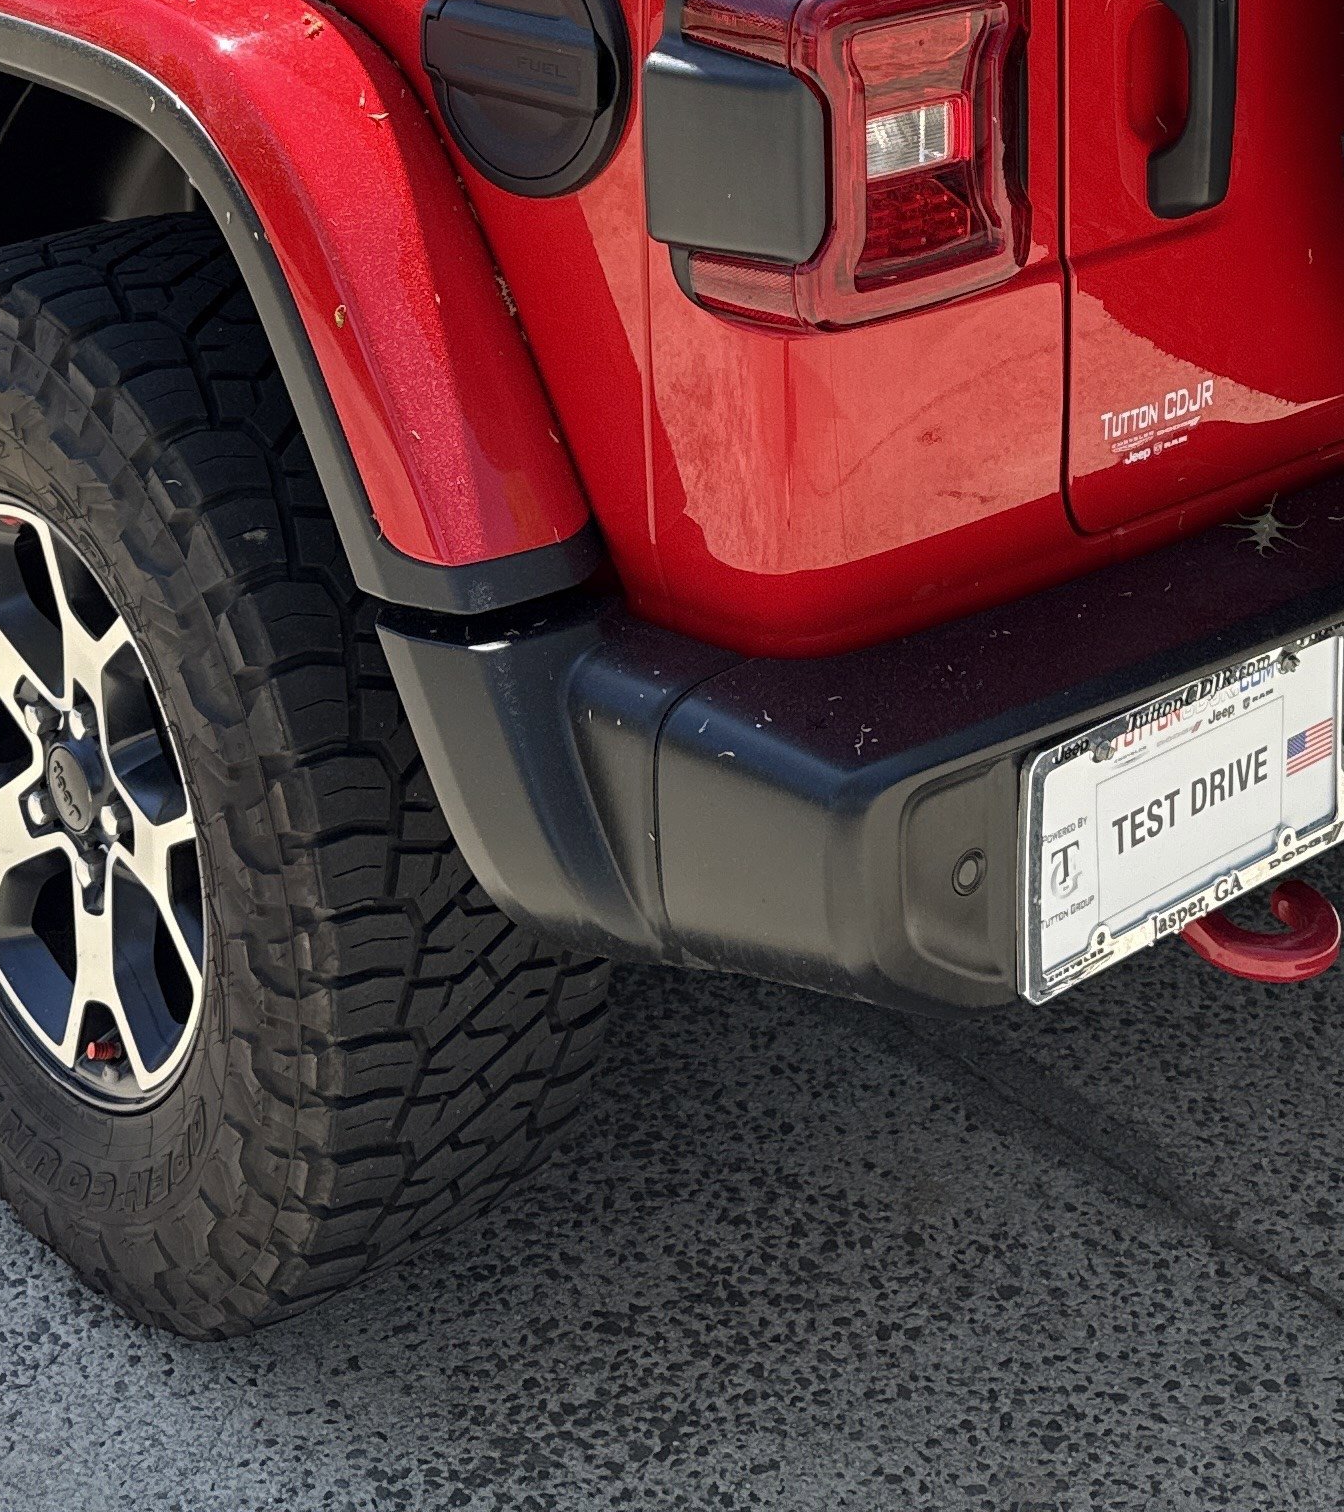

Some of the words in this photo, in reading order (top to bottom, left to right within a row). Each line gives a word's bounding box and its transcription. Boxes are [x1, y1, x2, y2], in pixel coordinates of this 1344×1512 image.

[515, 53, 568, 80] FUEL
[1164, 379, 1214, 421] CDJR
[1124, 447, 1152, 465] Jeep
[1055, 738, 1090, 765] Jeep
[1126, 654, 1272, 733] TuttonCDJR.com
[1208, 704, 1236, 725] Jeep
[53, 759, 82, 822] Jeep
[1112, 788, 1181, 855] TEST
[1191, 745, 1269, 818] DRIVE
[1077, 816, 1088, 829] BY
[1268, 832, 1333, 870] DODGE
[1041, 909, 1069, 931] TUTTON
[1070, 895, 1095, 916] GROUP
[1151, 895, 1210, 940] Jasper,
[1213, 872, 1244, 902] GA
